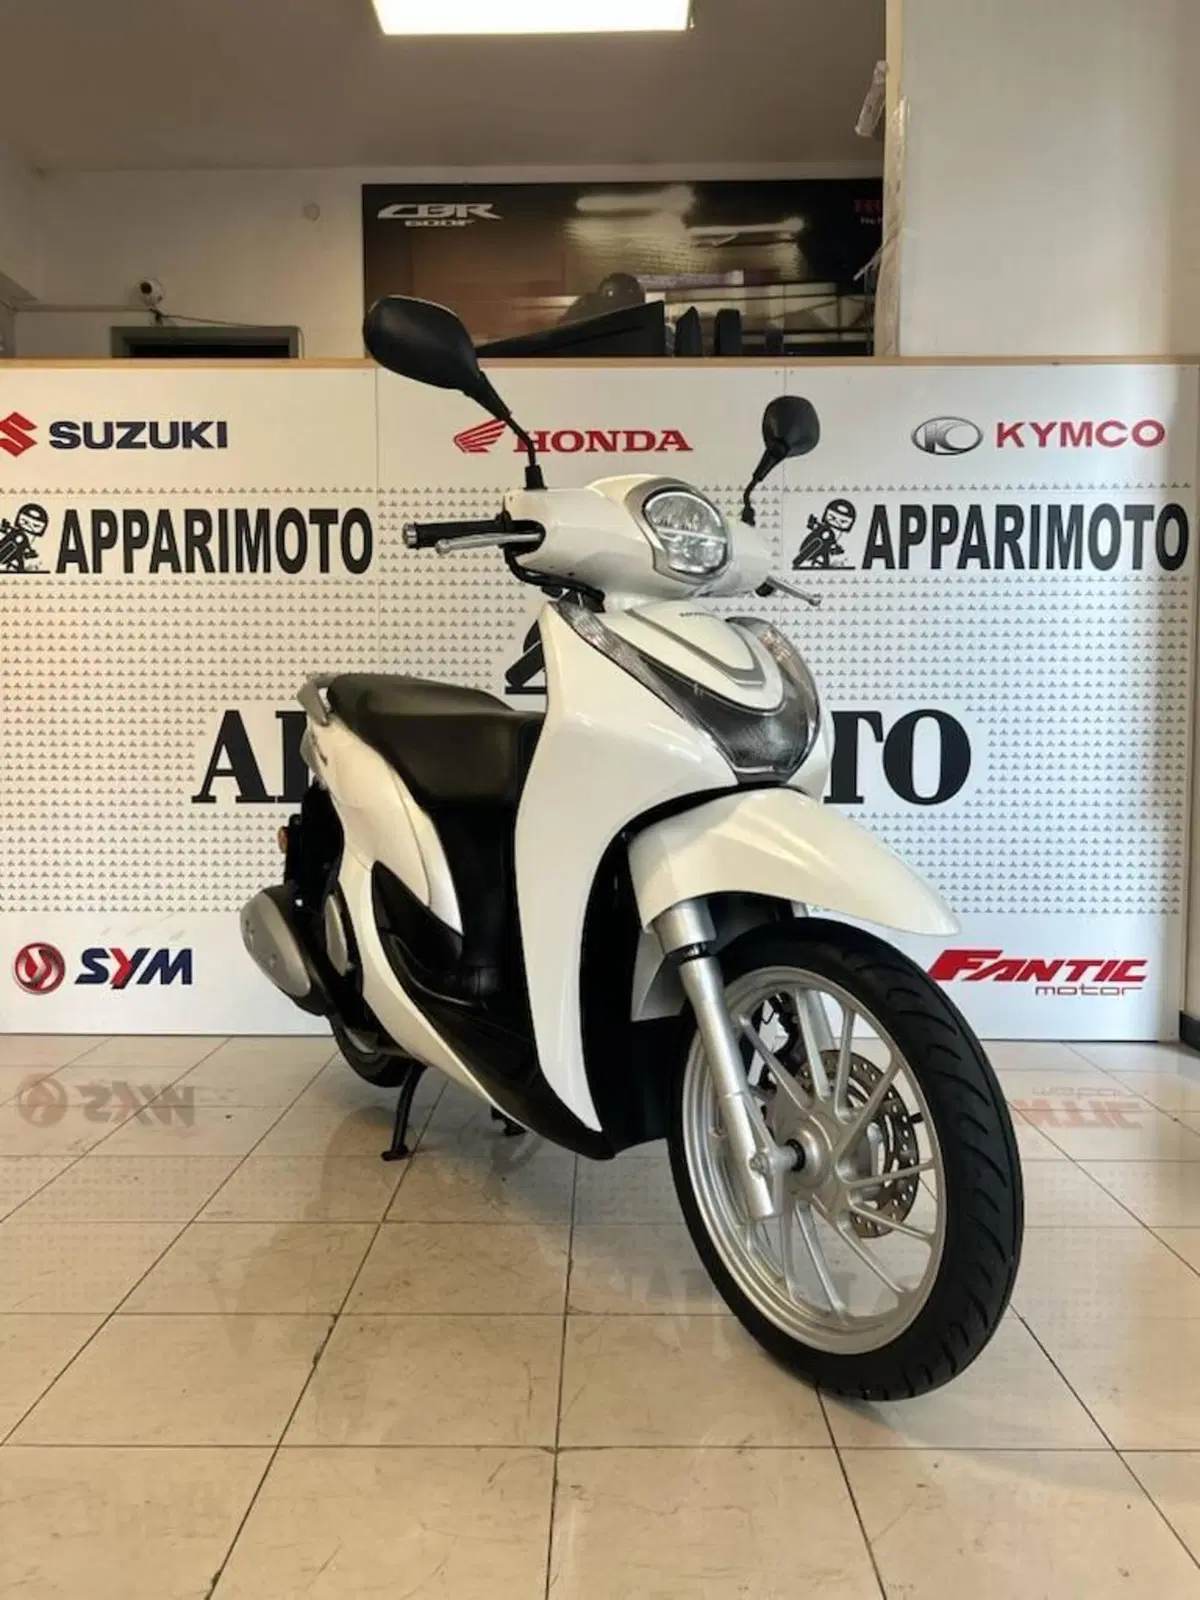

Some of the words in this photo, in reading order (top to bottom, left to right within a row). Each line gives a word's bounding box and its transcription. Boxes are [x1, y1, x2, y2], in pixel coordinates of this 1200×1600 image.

[377, 203, 503, 219] CBR
[49, 420, 228, 450] SUZUKI
[513, 430, 693, 453] HONDA
[996, 419, 1166, 448] KYMCO
[55, 507, 373, 574] APPARIMOTO
[862, 502, 1190, 572] APPARIMOTO
[74, 948, 193, 990] SYM
[1035, 985, 1143, 996] motor
